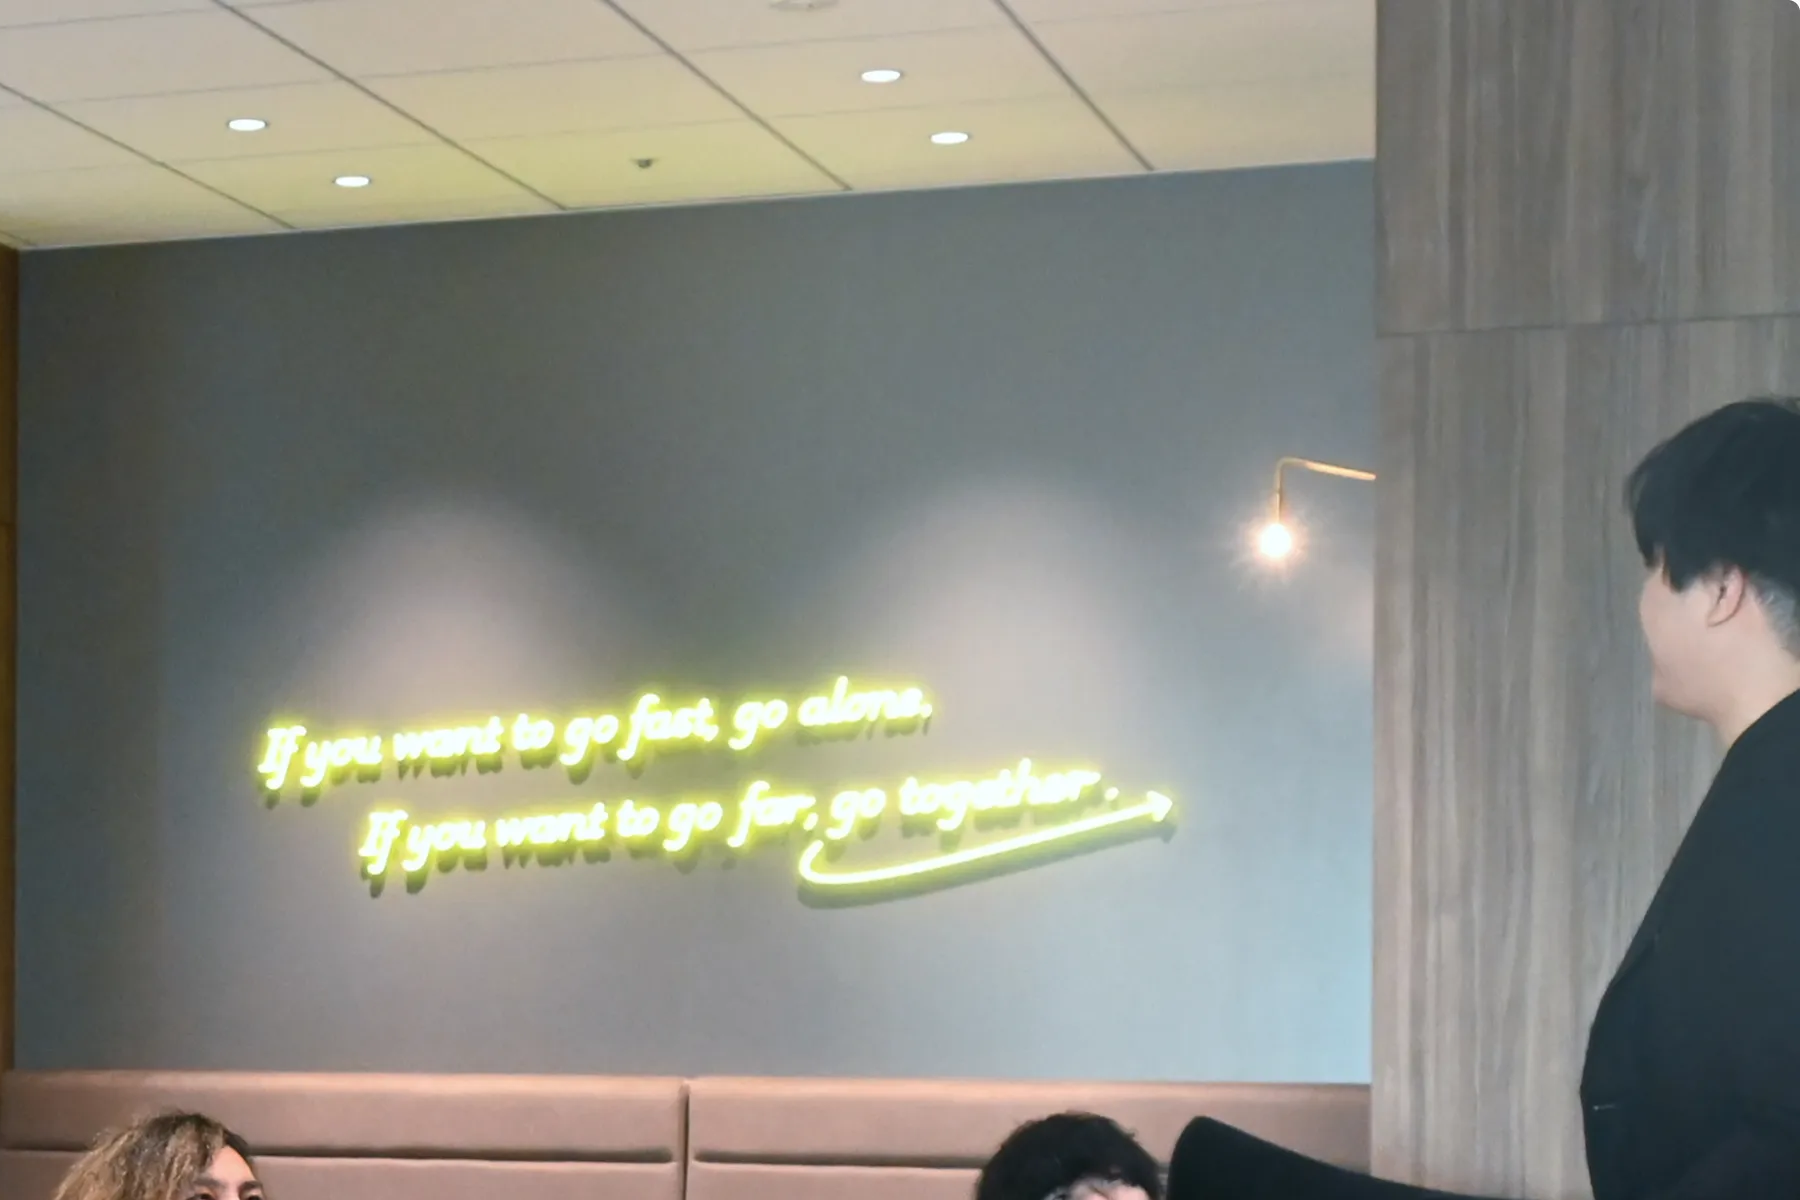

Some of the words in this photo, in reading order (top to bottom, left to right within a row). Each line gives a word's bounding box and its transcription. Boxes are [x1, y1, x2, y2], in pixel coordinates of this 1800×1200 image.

[256, 724, 309, 791] If
[299, 734, 383, 789] you
[392, 716, 505, 761] want
[510, 713, 556, 751] to
[559, 714, 621, 767] go
[616, 693, 720, 761] fast,
[727, 698, 790, 751] go
[797, 675, 933, 728] alone.
[357, 808, 411, 876] If
[401, 819, 488, 873] you
[494, 801, 610, 848] want
[614, 798, 661, 838] to
[662, 799, 725, 853] go
[726, 779, 819, 848] far,
[825, 786, 889, 841] go
